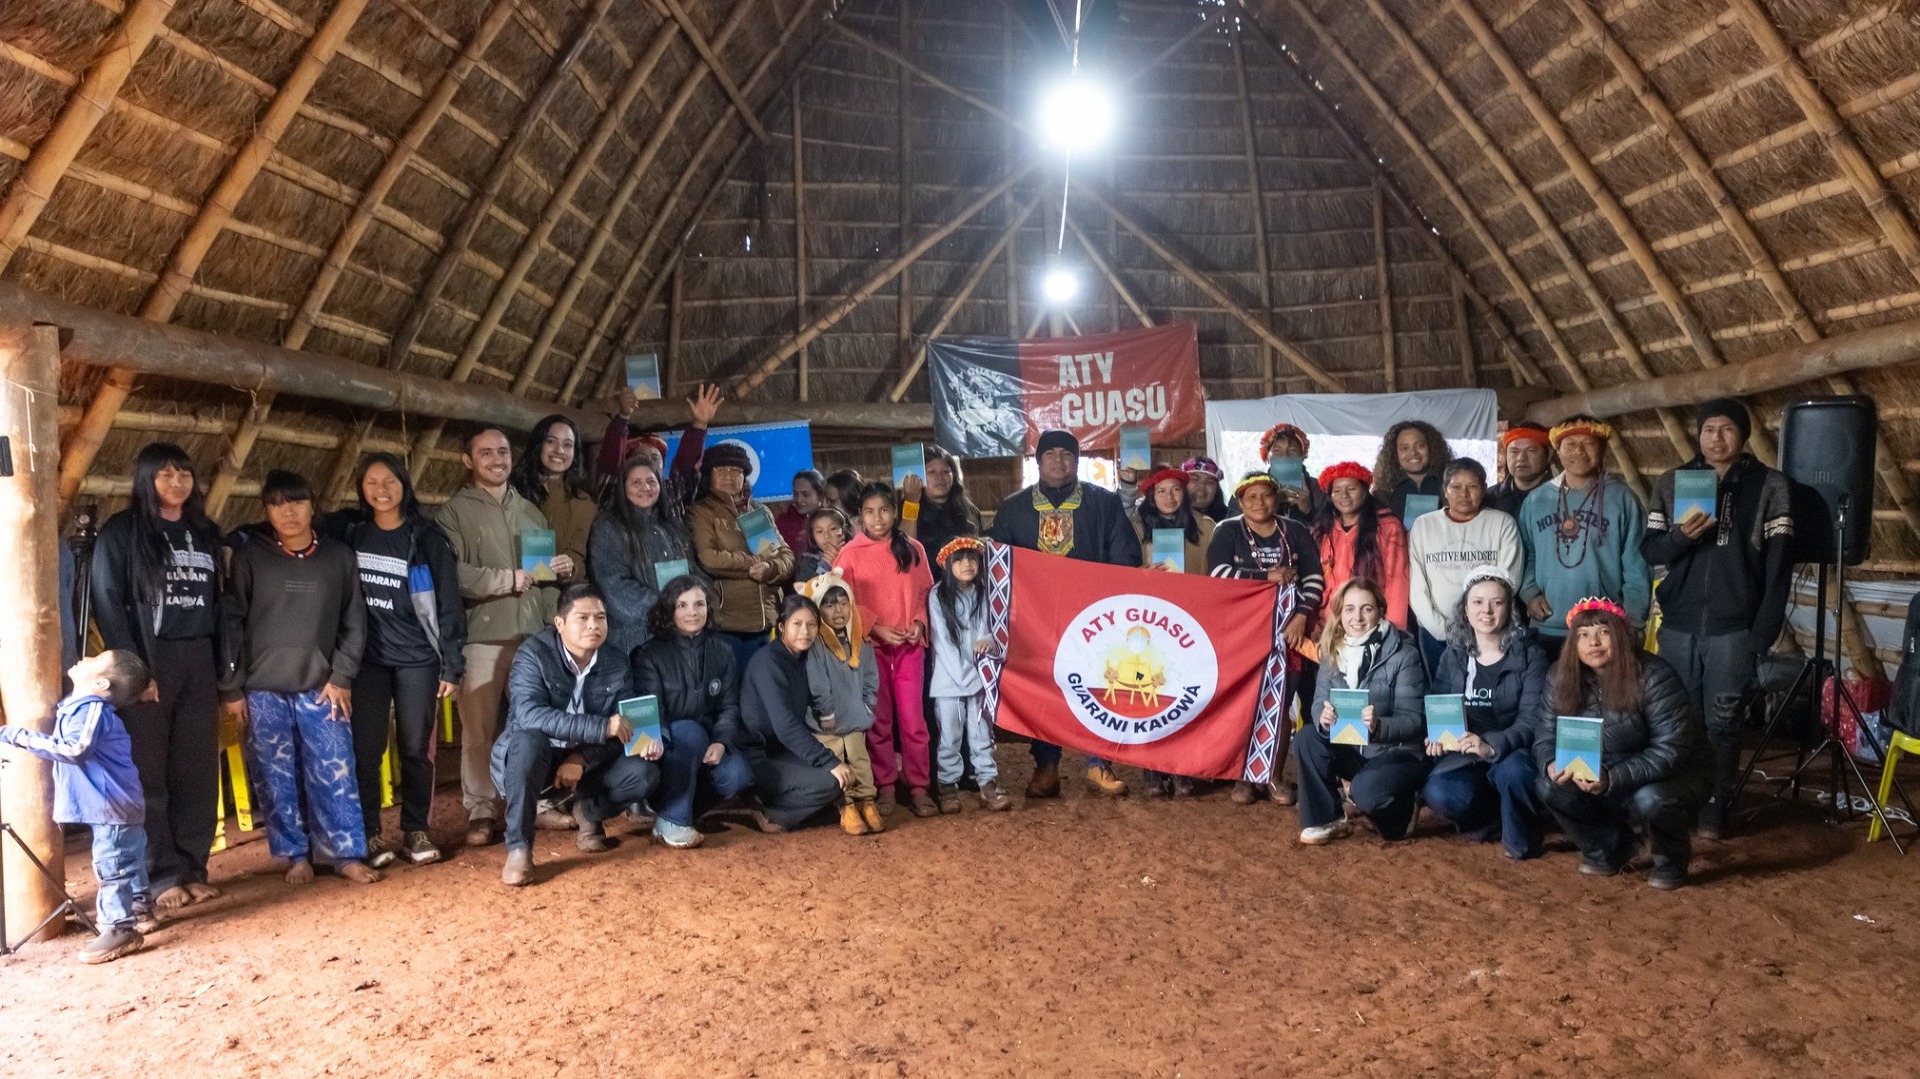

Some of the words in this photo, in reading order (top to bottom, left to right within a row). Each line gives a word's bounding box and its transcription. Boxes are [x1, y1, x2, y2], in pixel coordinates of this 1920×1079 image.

[1058, 352, 1114, 387] ATY
[1061, 381, 1168, 428] GUASÚ
[366, 596, 394, 611] IOWÁ
[1081, 610, 1116, 644] ATY
[1125, 608, 1196, 649] GUASU
[1067, 672, 1129, 733] GUARANI
[1133, 684, 1202, 734] KAIOWÁ
